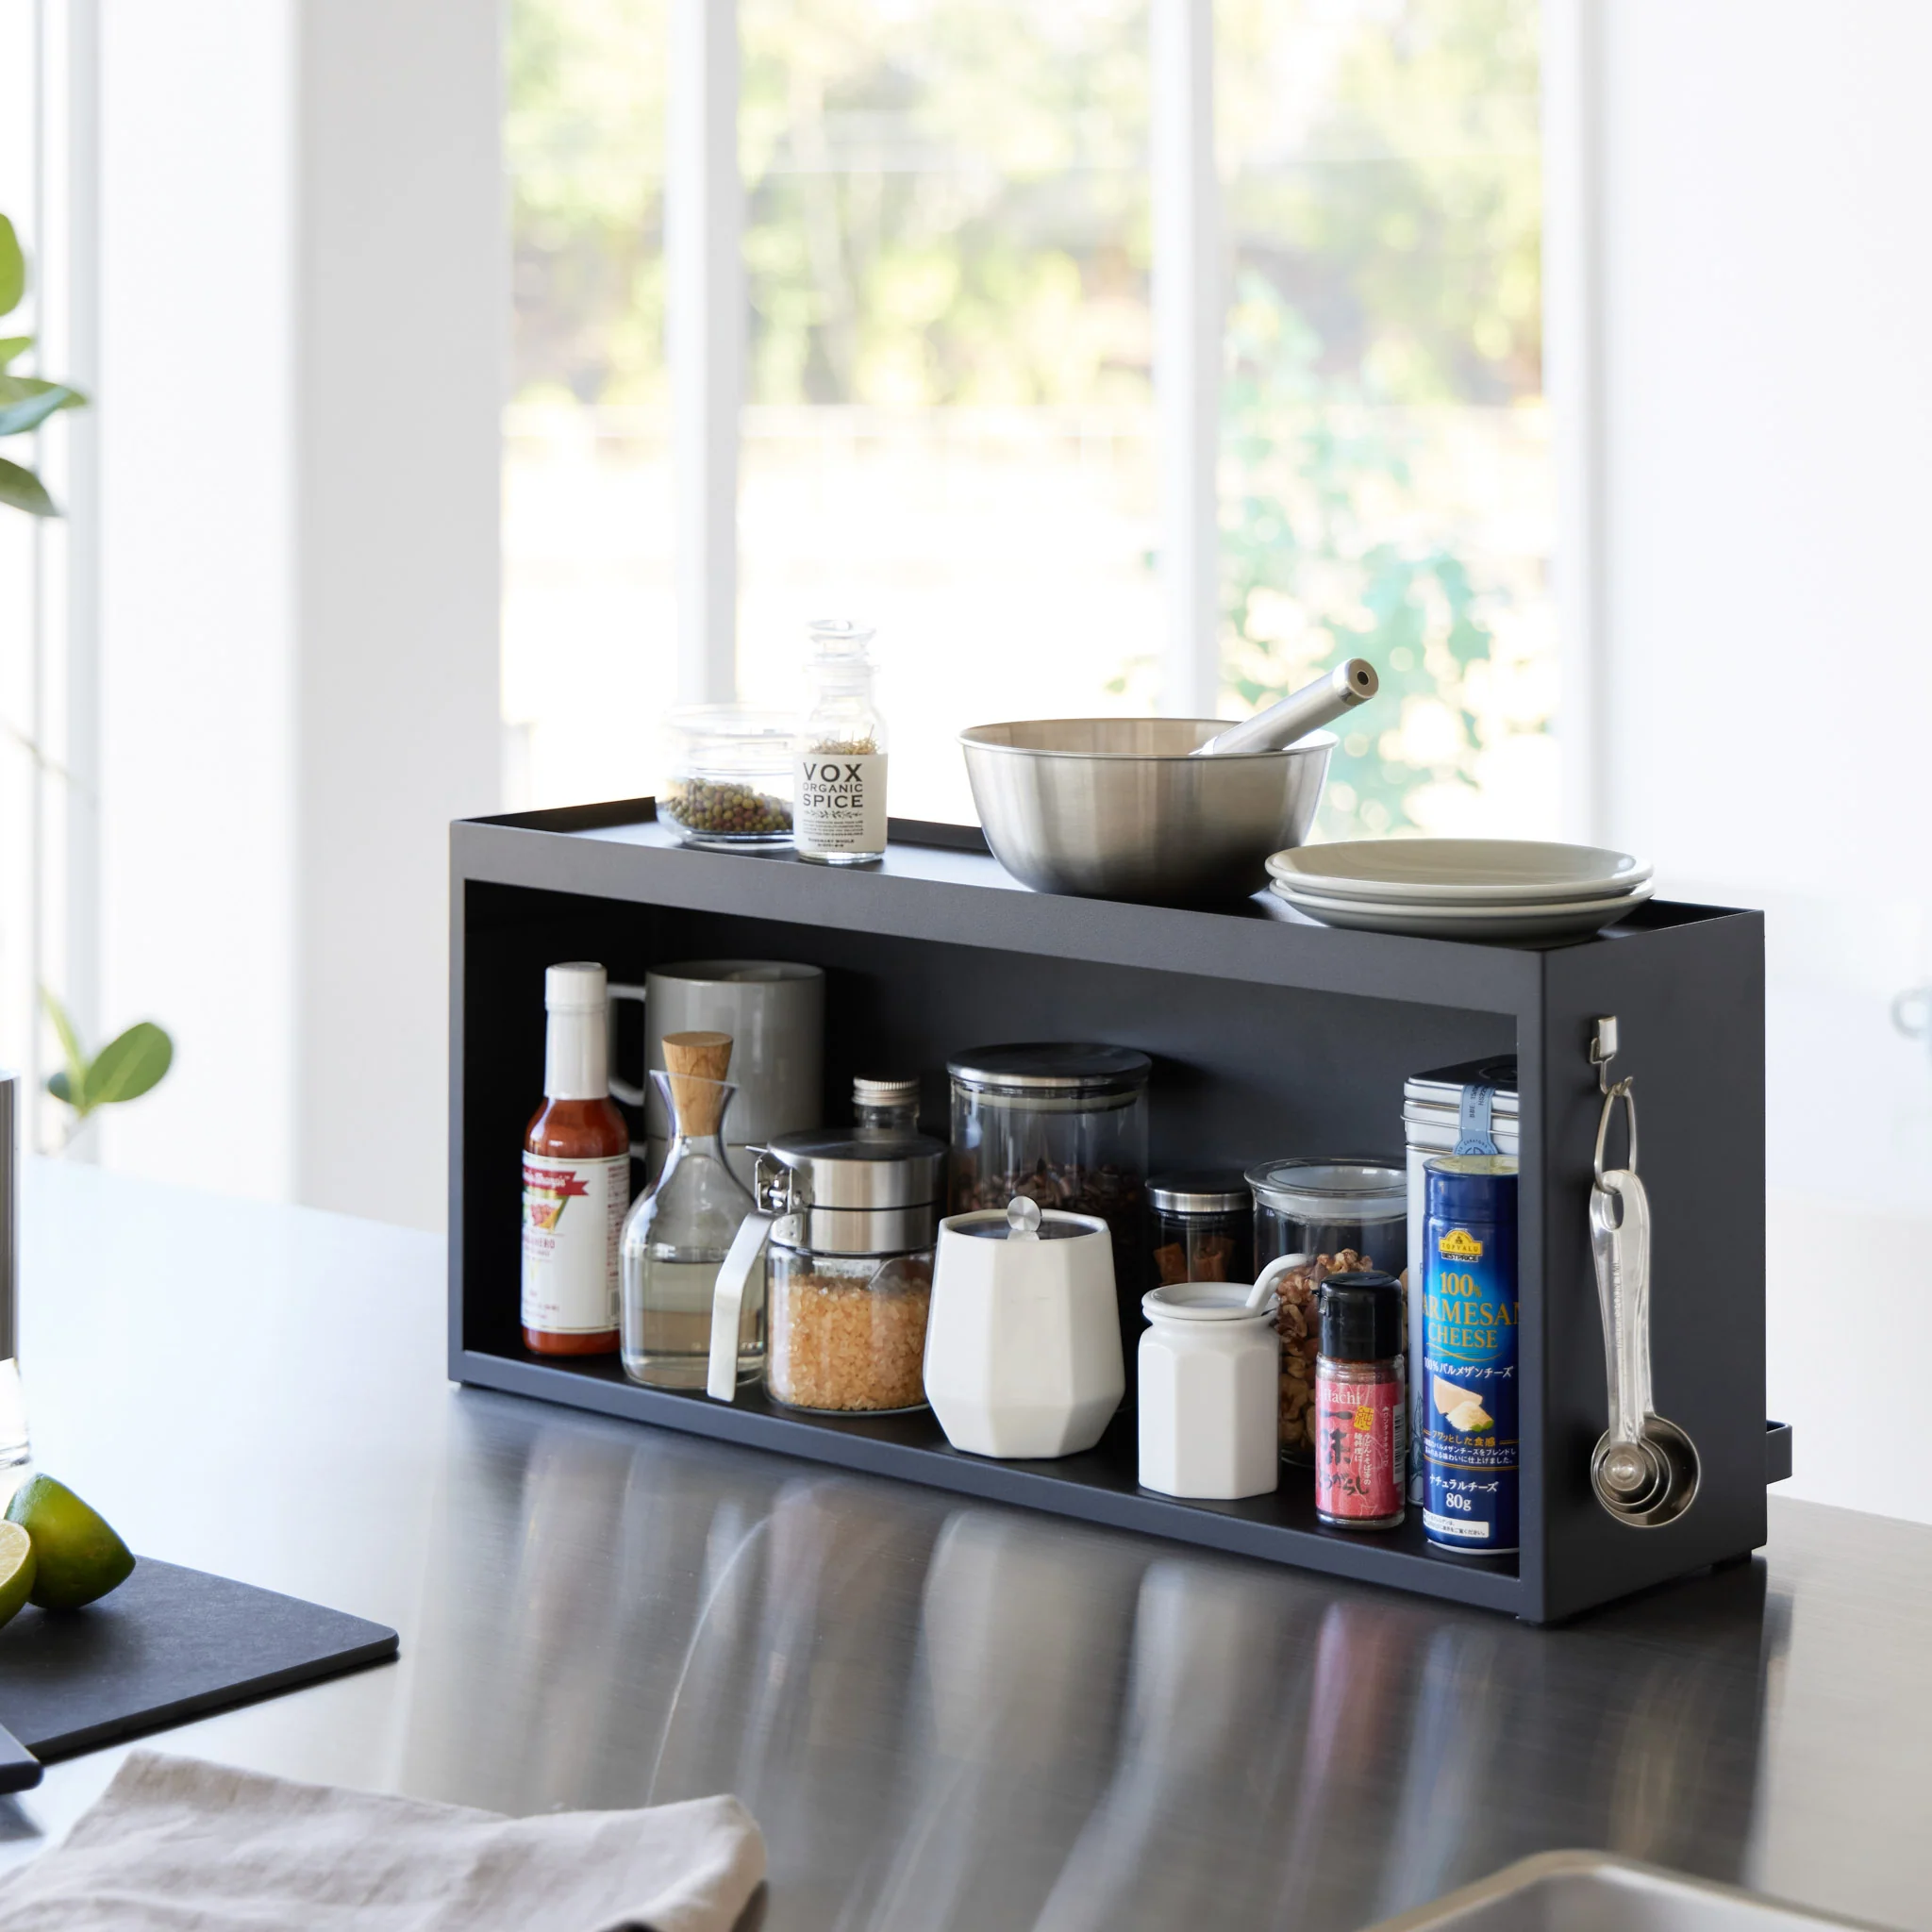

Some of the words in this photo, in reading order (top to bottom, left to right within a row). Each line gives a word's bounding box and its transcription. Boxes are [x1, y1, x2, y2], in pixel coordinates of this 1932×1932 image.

[803, 762, 863, 782] VOX
[803, 783, 863, 792] ORGANIC
[803, 793, 863, 808] SPICE
[1441, 1242, 1478, 1253] TOPVALU
[1441, 1272, 1482, 1298] 100%
[1423, 1293, 1520, 1326] ARMESA
[1427, 1323, 1498, 1348] CHEESE
[1432, 1430, 1496, 1447] フワッとした食感
[1429, 1474, 1499, 1493] ナチュラルチーズ
[1445, 1492, 1473, 1511] 80g
